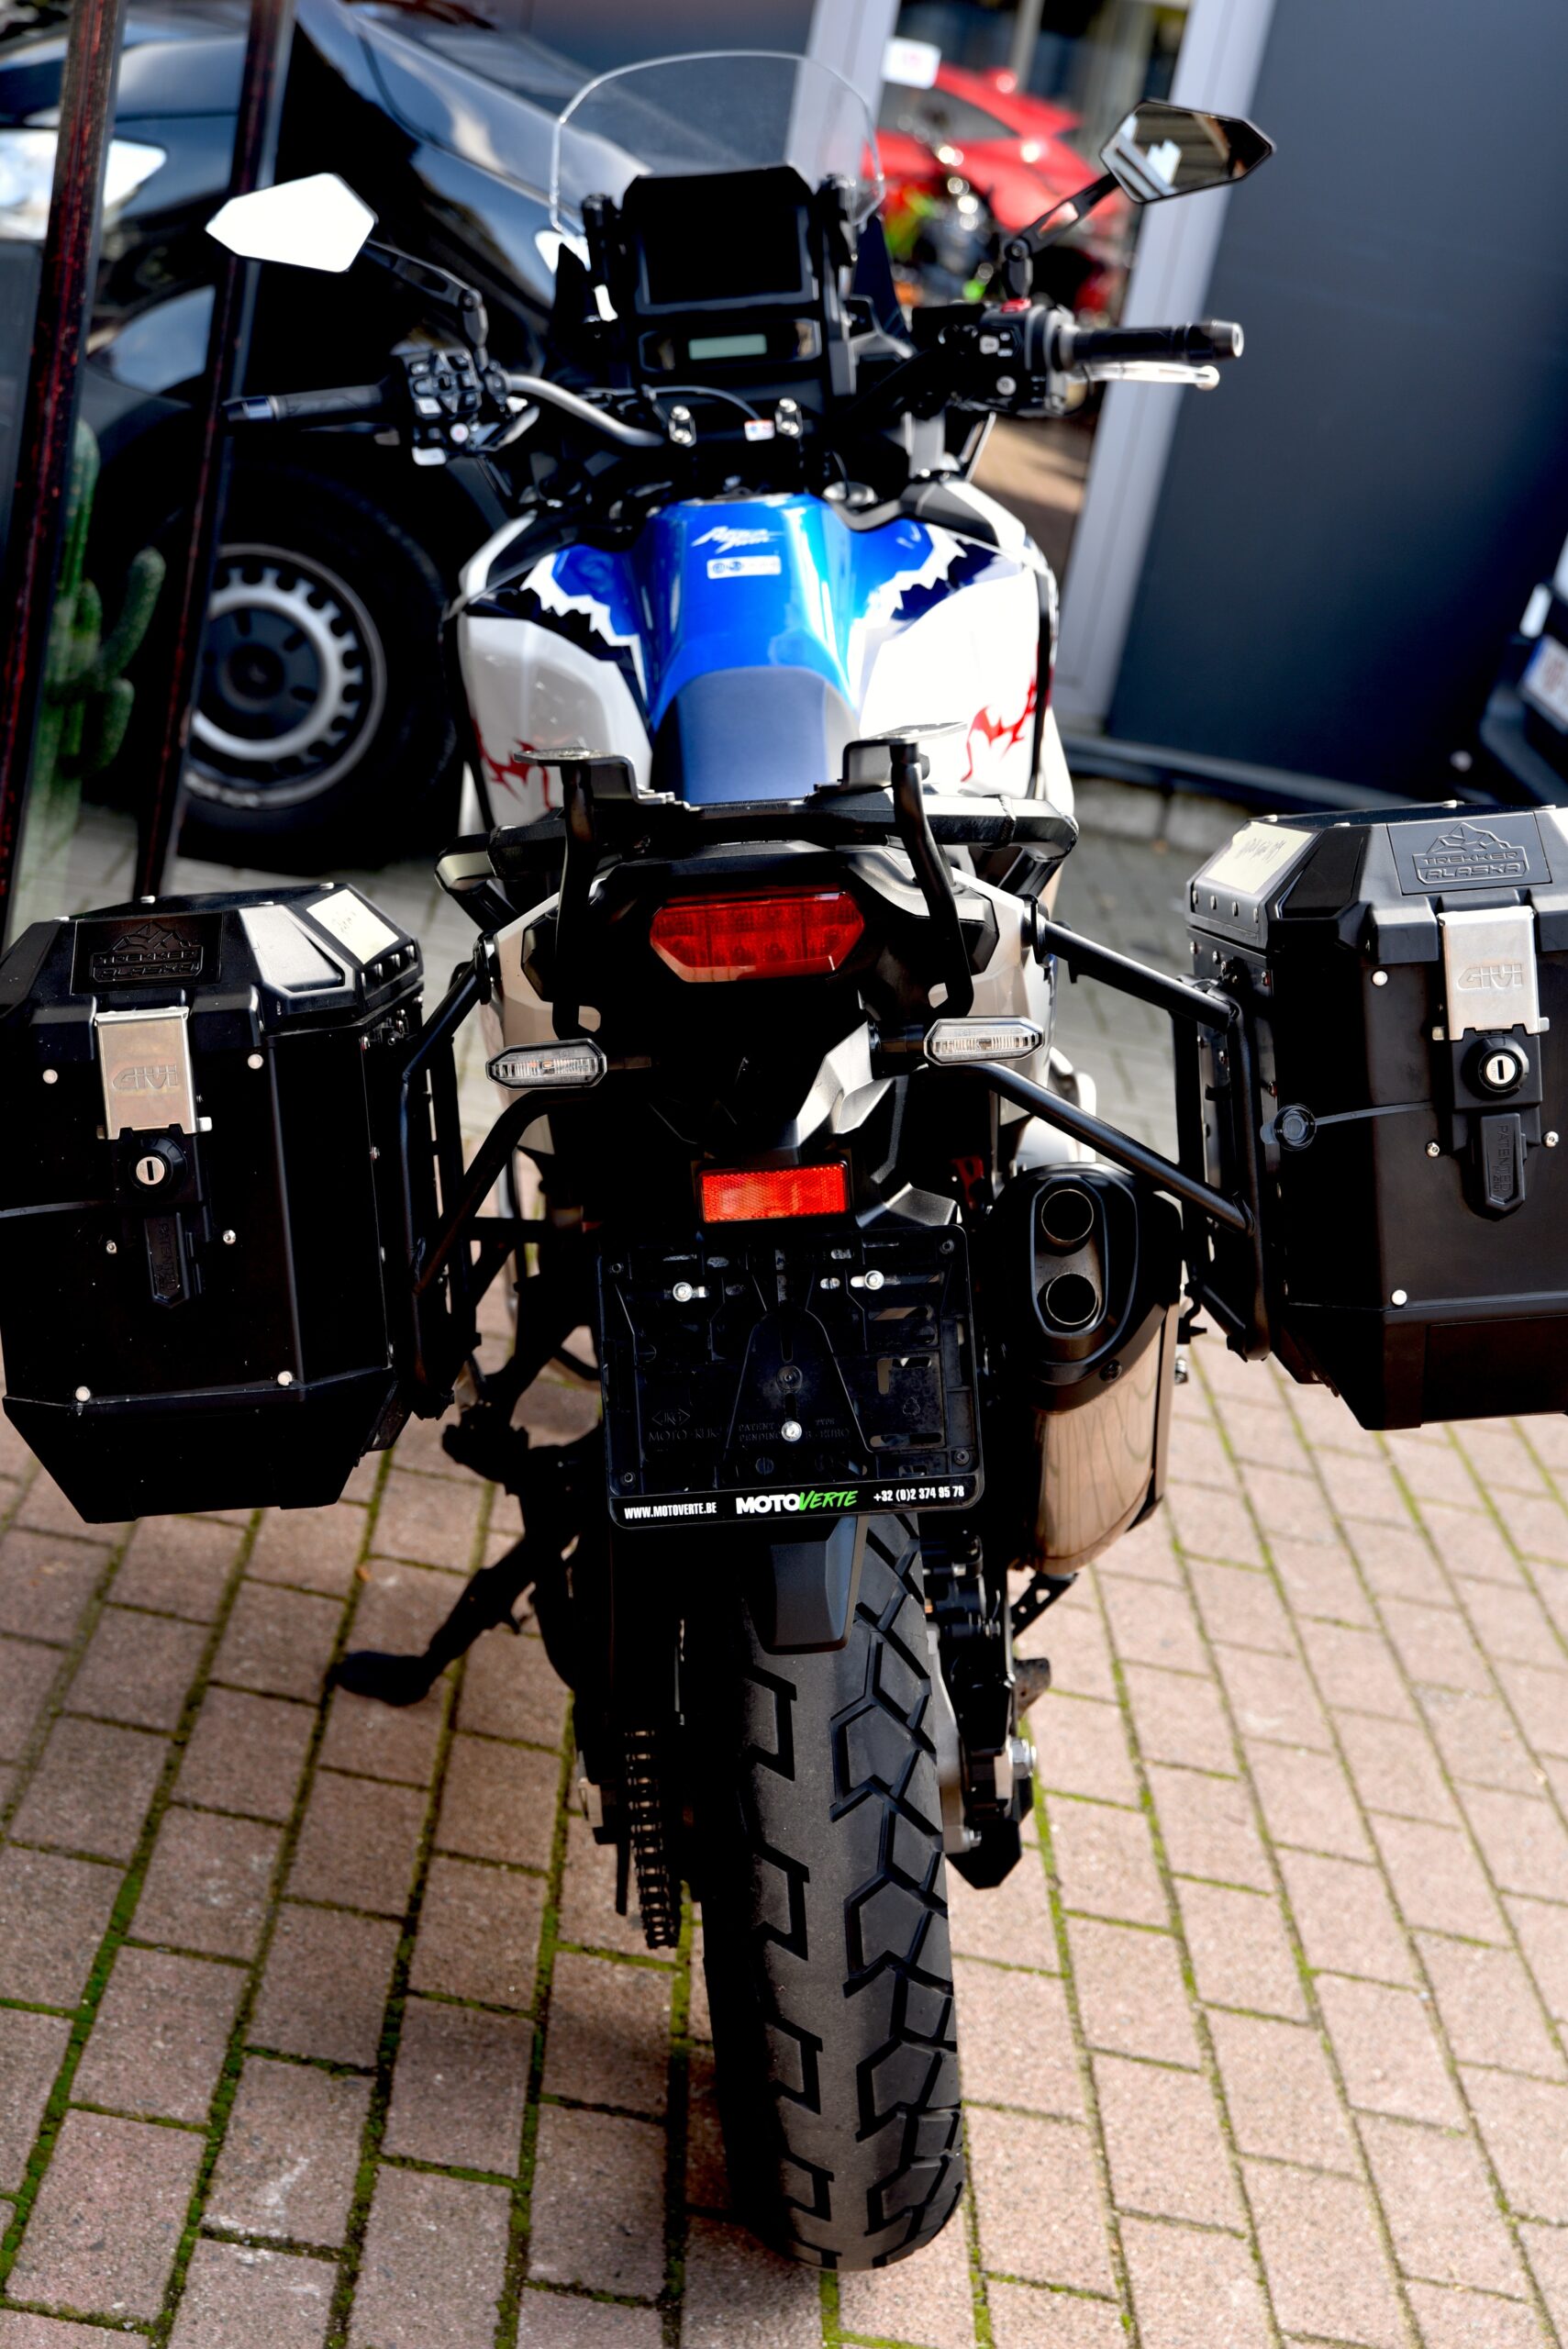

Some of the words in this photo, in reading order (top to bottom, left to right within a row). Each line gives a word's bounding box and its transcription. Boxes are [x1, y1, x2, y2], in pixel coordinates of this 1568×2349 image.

[1422, 852, 1518, 865] TREKKER
[1425, 863, 1521, 879] ALASKA
[99, 950, 196, 963] TREKKER
[1456, 963, 1523, 990] GIVI
[111, 1063, 178, 1090] GIVI
[1496, 1125, 1512, 1194] PATENTED
[873, 1490, 894, 1502] +32
[895, 1488, 917, 1502] (0)2
[918, 1487, 937, 1499] 374
[938, 1486, 951, 1498] 95
[952, 1486, 965, 1497] 78
[624, 1502, 717, 1520] WWW.MOTOVERTE.BE
